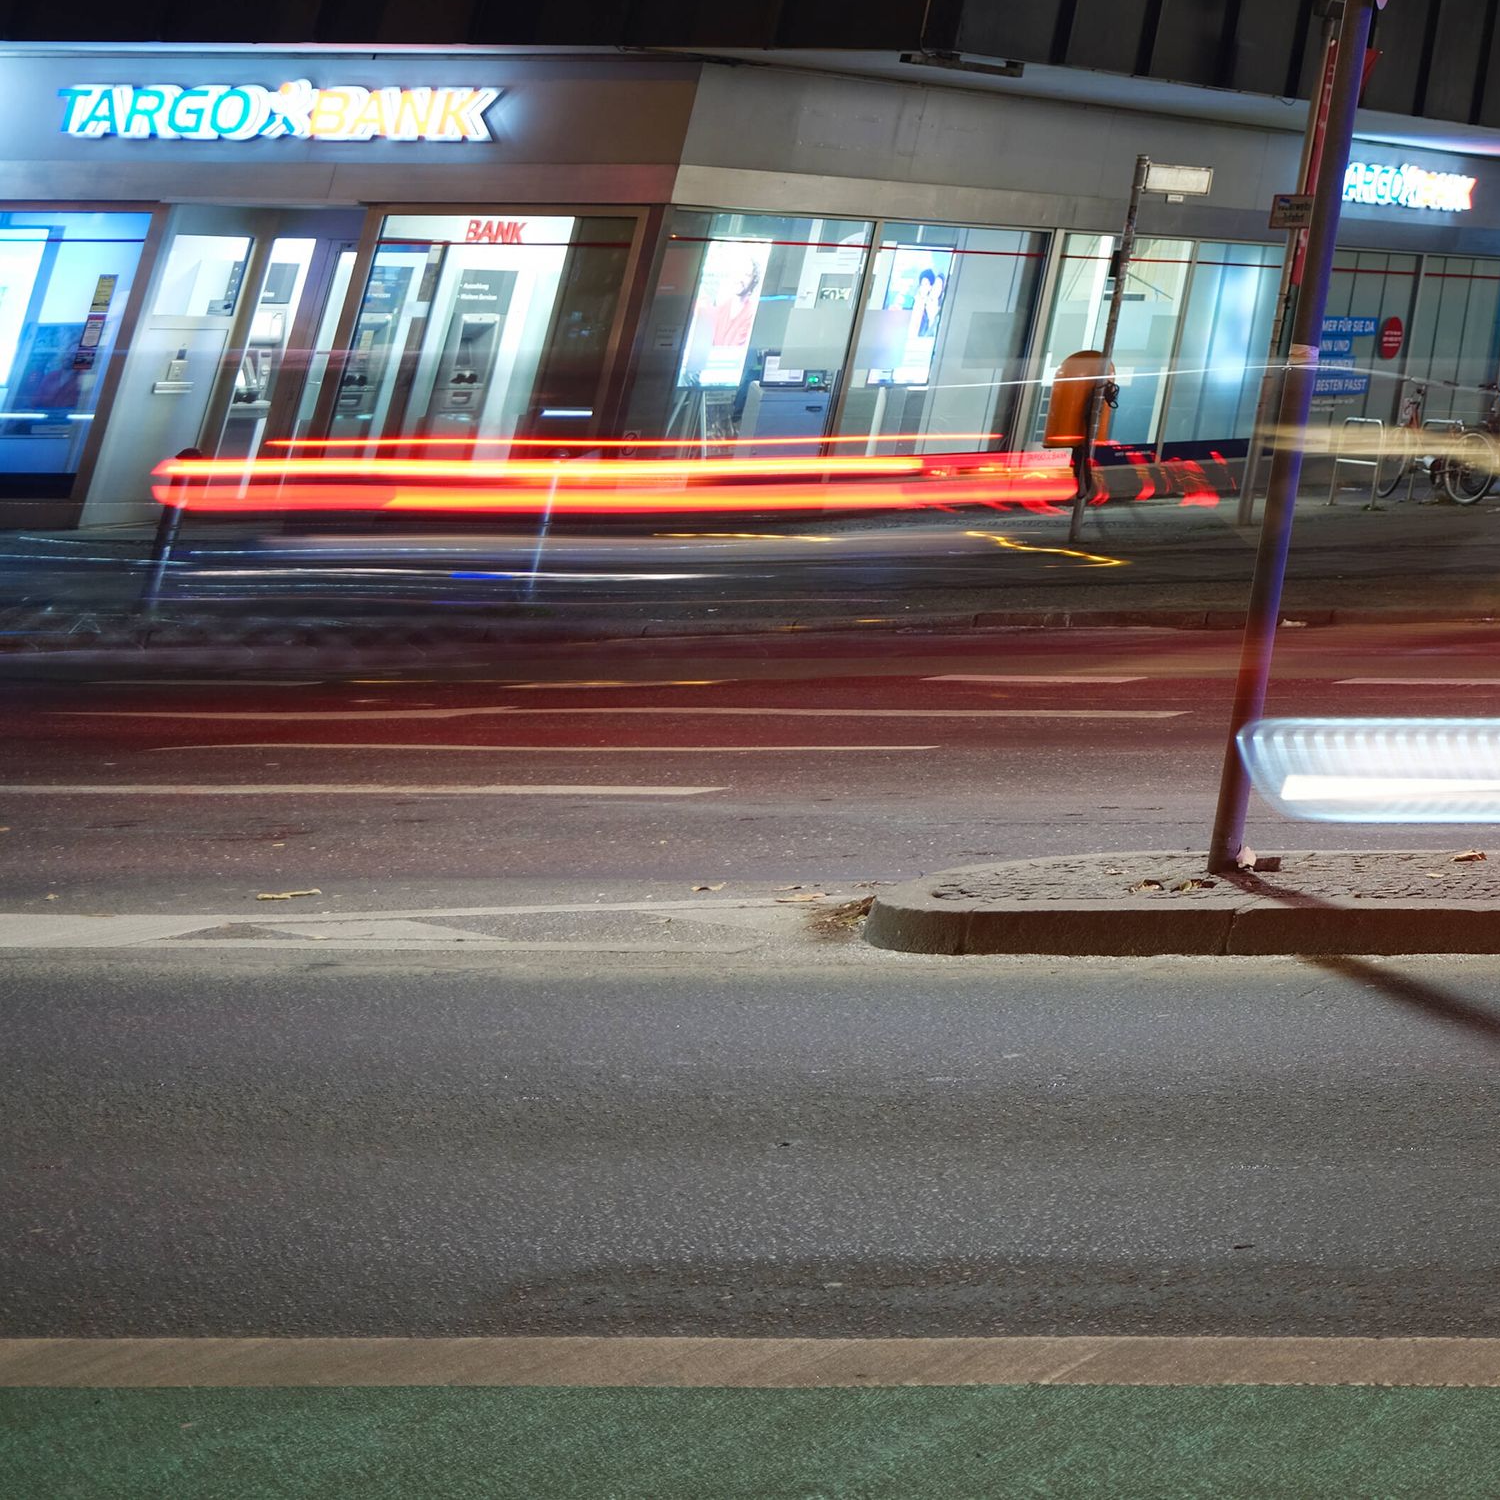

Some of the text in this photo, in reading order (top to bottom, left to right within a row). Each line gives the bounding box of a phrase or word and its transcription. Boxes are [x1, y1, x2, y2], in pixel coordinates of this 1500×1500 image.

[465, 219, 527, 244] BANK
[1338, 317, 1352, 332] FÜR
[1352, 320, 1364, 332] SIE
[1364, 320, 1375, 332] DA
[1315, 378, 1367, 392] BESTEN PASST
